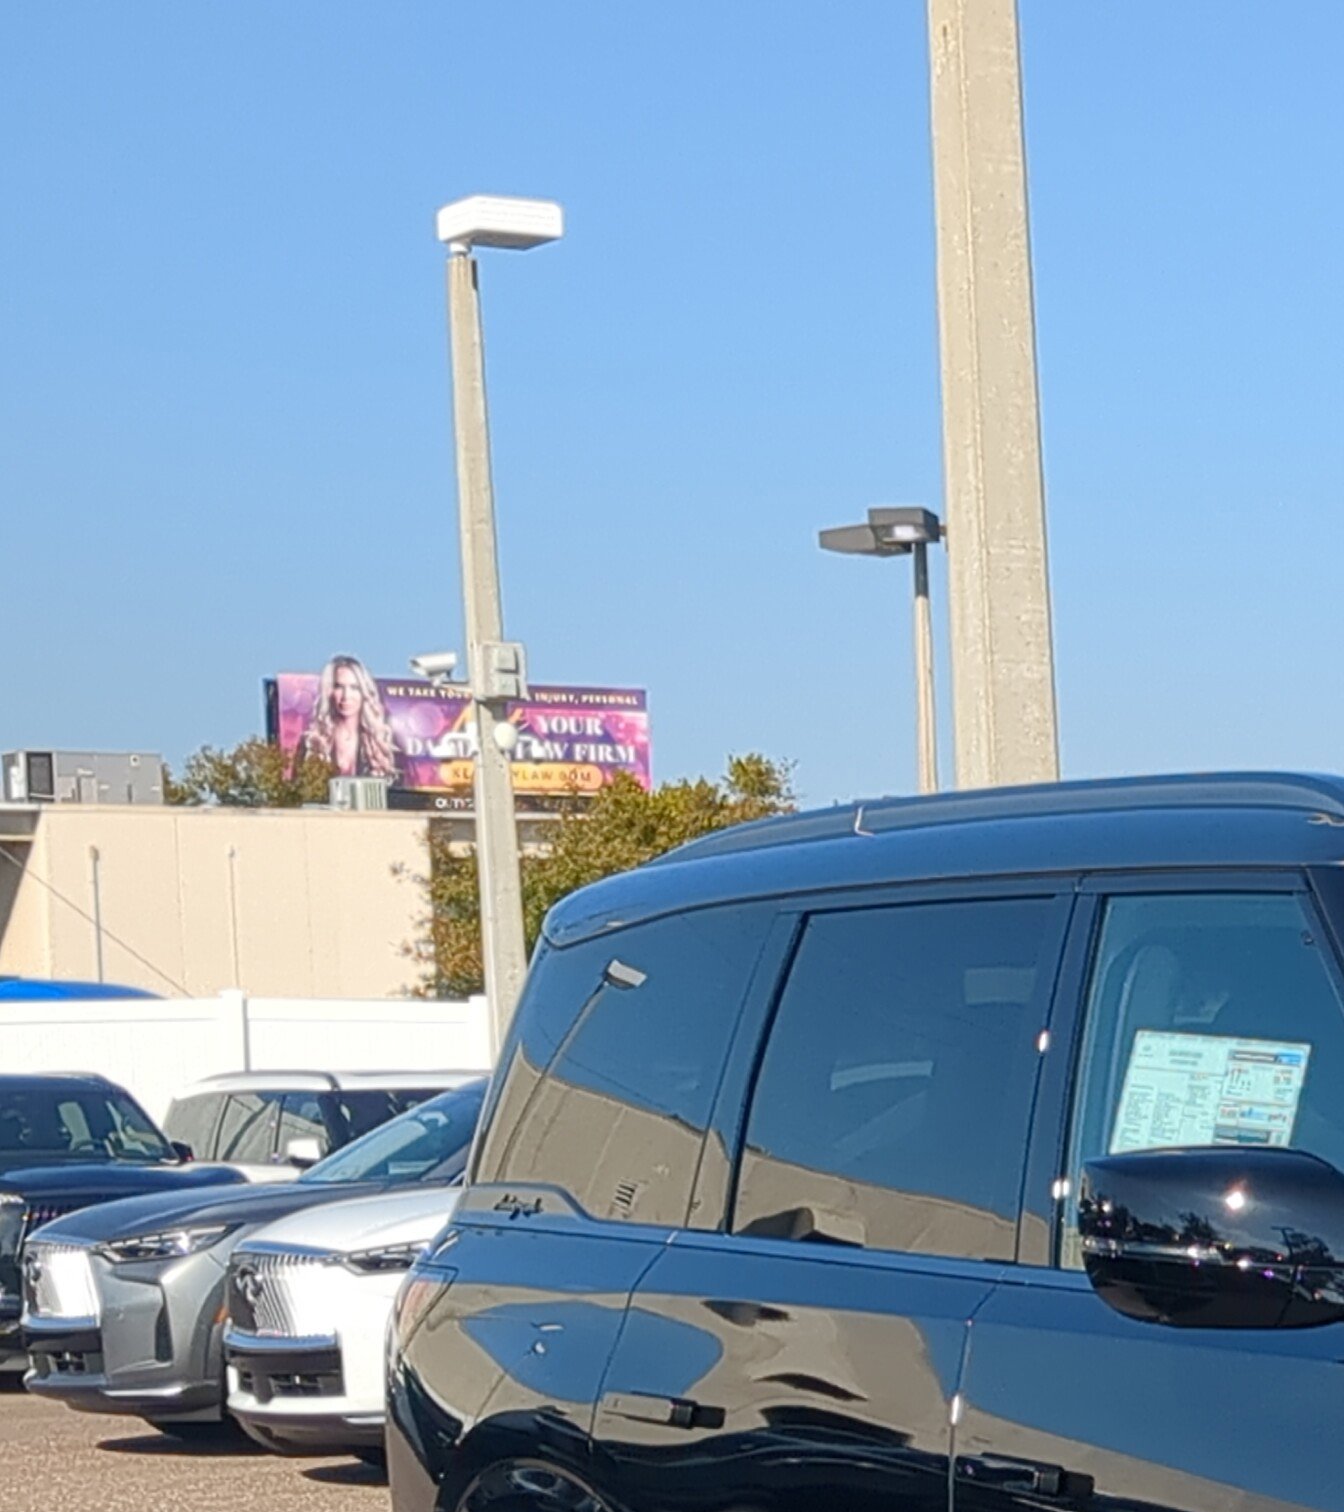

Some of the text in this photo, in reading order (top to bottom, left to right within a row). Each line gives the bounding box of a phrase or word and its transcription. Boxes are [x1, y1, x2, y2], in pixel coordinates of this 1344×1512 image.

[386, 687, 404, 696] WE
[535, 715, 604, 736] YOUR
[573, 742, 637, 764] FIRM
